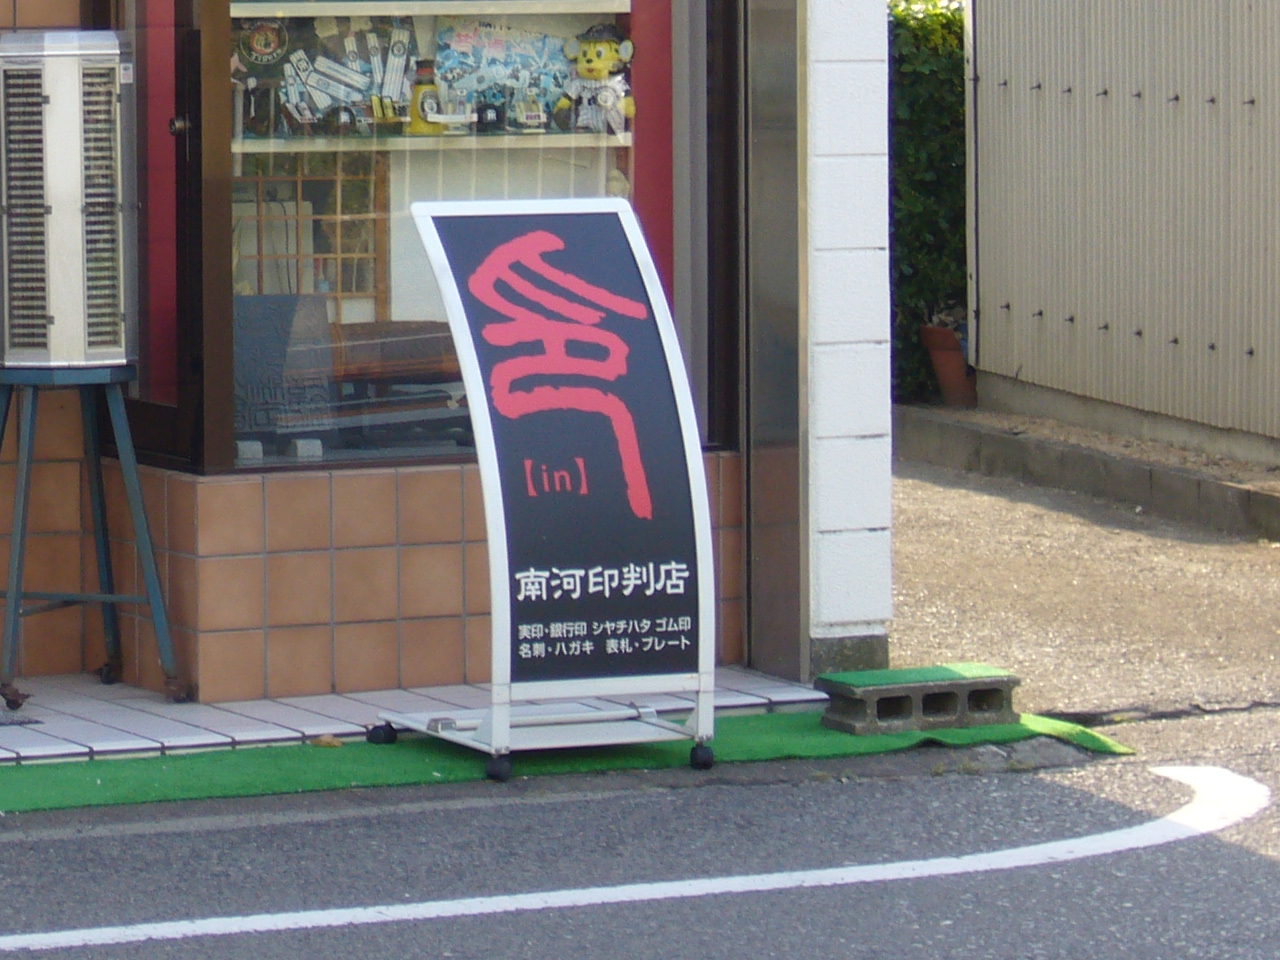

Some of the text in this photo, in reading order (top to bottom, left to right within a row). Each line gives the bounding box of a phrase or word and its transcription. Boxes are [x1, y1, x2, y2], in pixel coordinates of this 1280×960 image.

[514, 560, 691, 602] 南河印判店
[518, 621, 588, 640] 実印・銀行印
[655, 616, 692, 633] ゴム印
[518, 635, 691, 659] 名刺・ハガキ 表札・プレート
